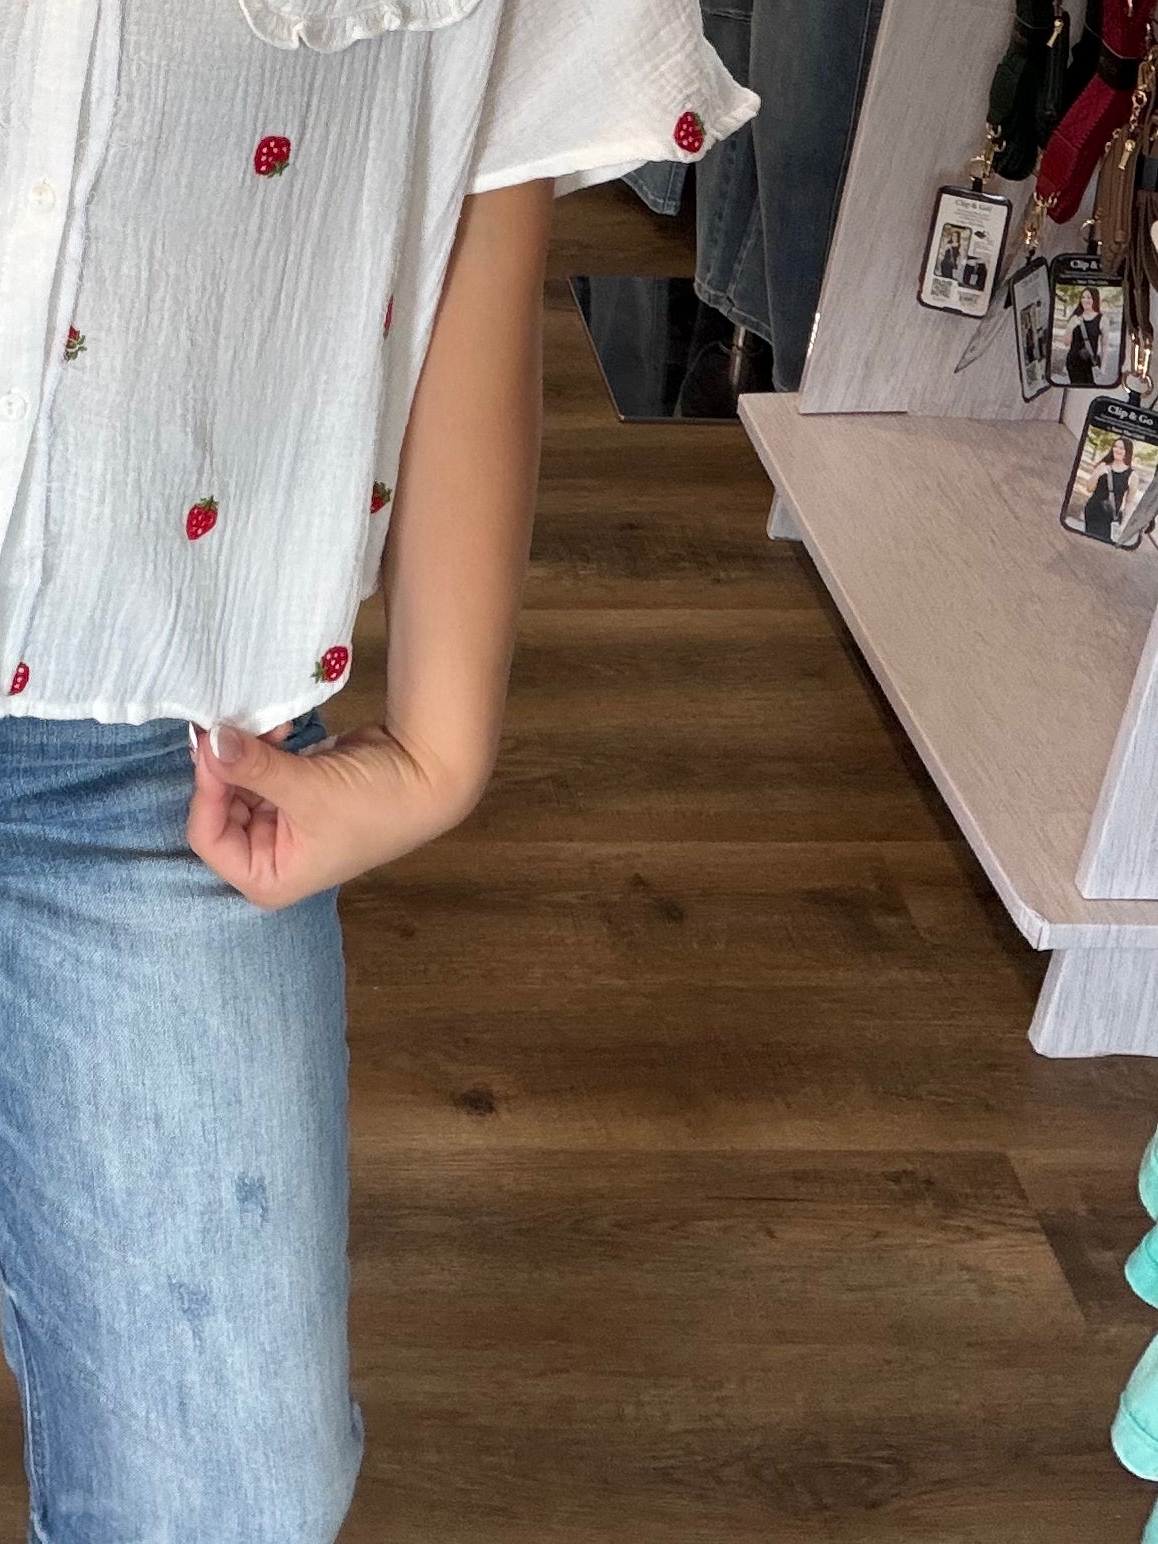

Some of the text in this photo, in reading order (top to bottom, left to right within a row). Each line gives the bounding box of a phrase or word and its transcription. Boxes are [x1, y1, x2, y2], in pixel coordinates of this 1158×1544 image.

[1070, 259, 1090, 271] Clip
[1089, 260, 1098, 270] &
[1107, 404, 1129, 420] Clip
[1128, 411, 1138, 421] &
[1138, 413, 1154, 426] Go
